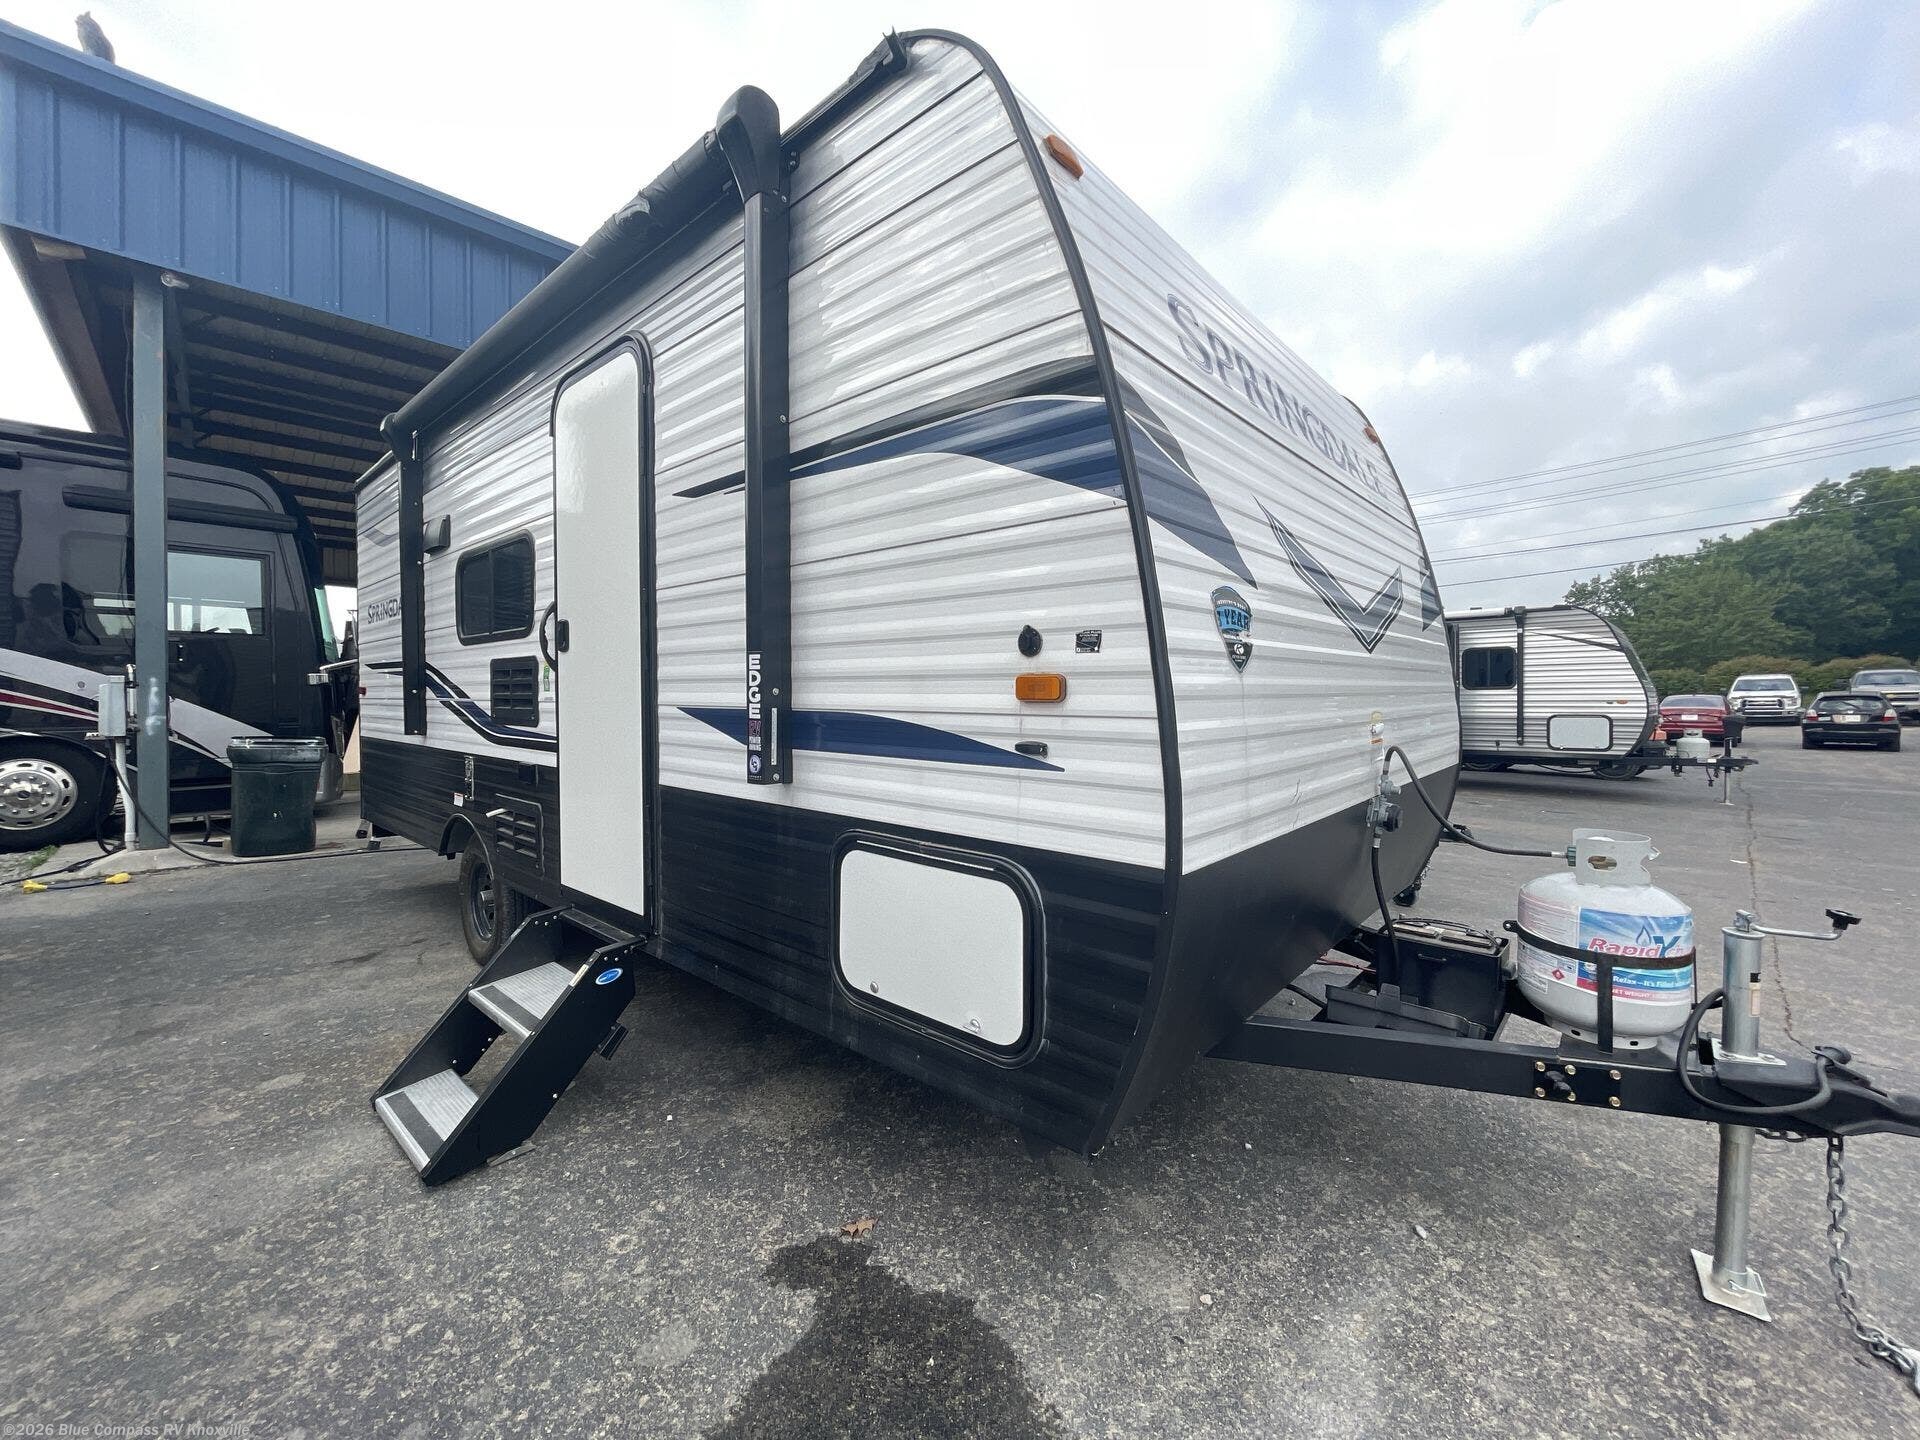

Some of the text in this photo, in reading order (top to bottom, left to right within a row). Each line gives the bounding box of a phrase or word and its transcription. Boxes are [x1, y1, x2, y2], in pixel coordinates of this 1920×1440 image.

[1166, 293, 1389, 500] SPRINGDALE
[748, 653, 762, 719] EDGE
[1613, 975, 1637, 985] Relax
